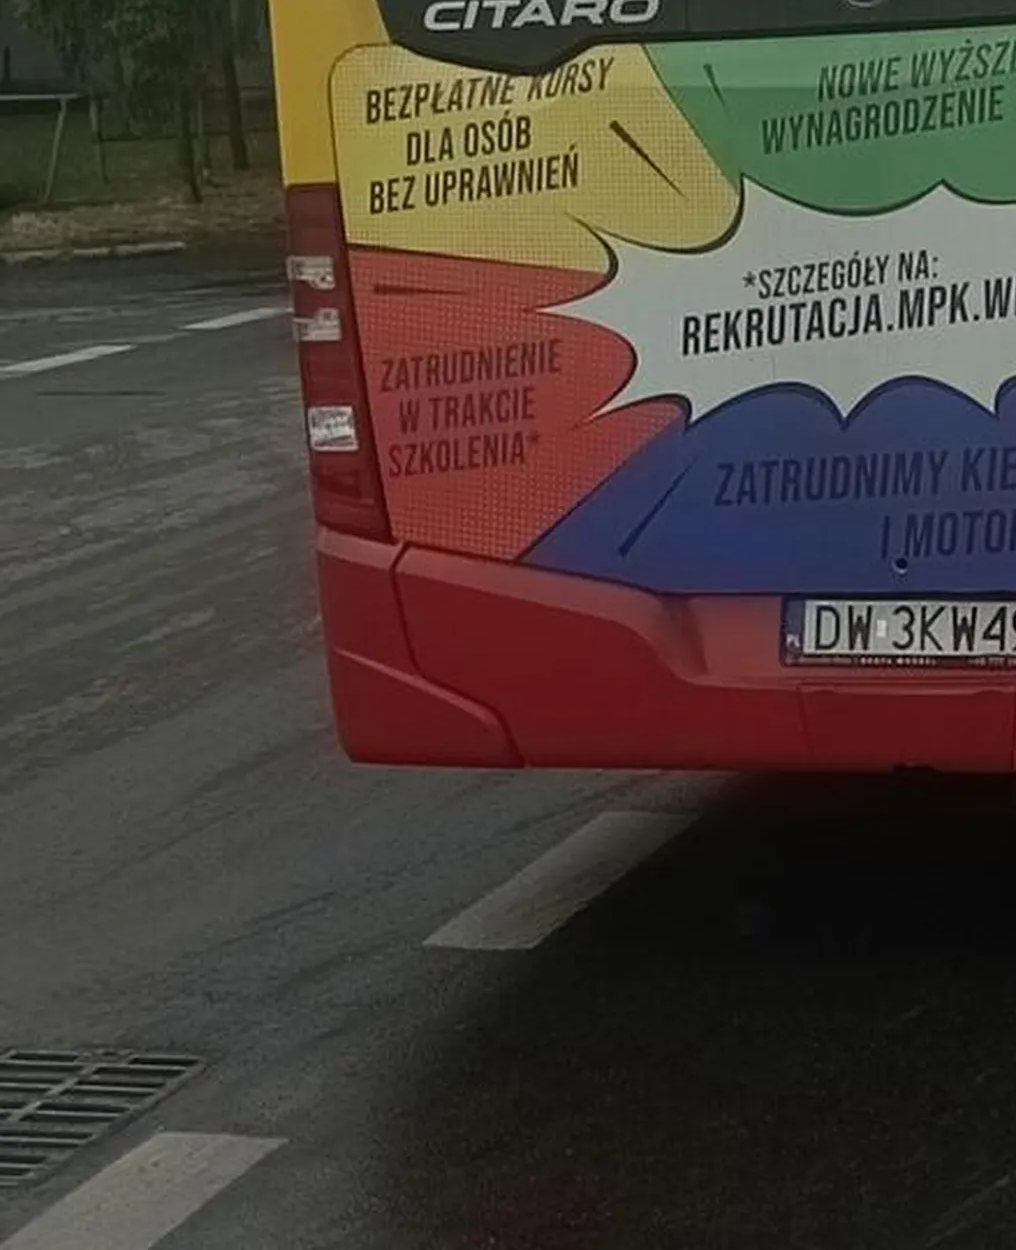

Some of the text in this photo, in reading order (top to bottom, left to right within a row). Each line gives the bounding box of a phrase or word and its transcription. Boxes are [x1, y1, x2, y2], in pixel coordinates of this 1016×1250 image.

[366, 76, 516, 124] BEZPŁATNE
[818, 57, 902, 102] NOWE
[406, 110, 532, 166] DLA OSÓB
[761, 85, 1005, 154] WYNAGRODZENIE
[370, 144, 580, 214] BEZ UPRAWNIEŃ
[899, 250, 939, 282] NA:
[379, 338, 563, 393] ZATRUDNIENIE
[399, 386, 536, 434] W TRAKCIE
[714, 448, 949, 507] ZATRUDNIMY
[880, 514, 891, 560] I
[813, 604, 874, 652] DW
